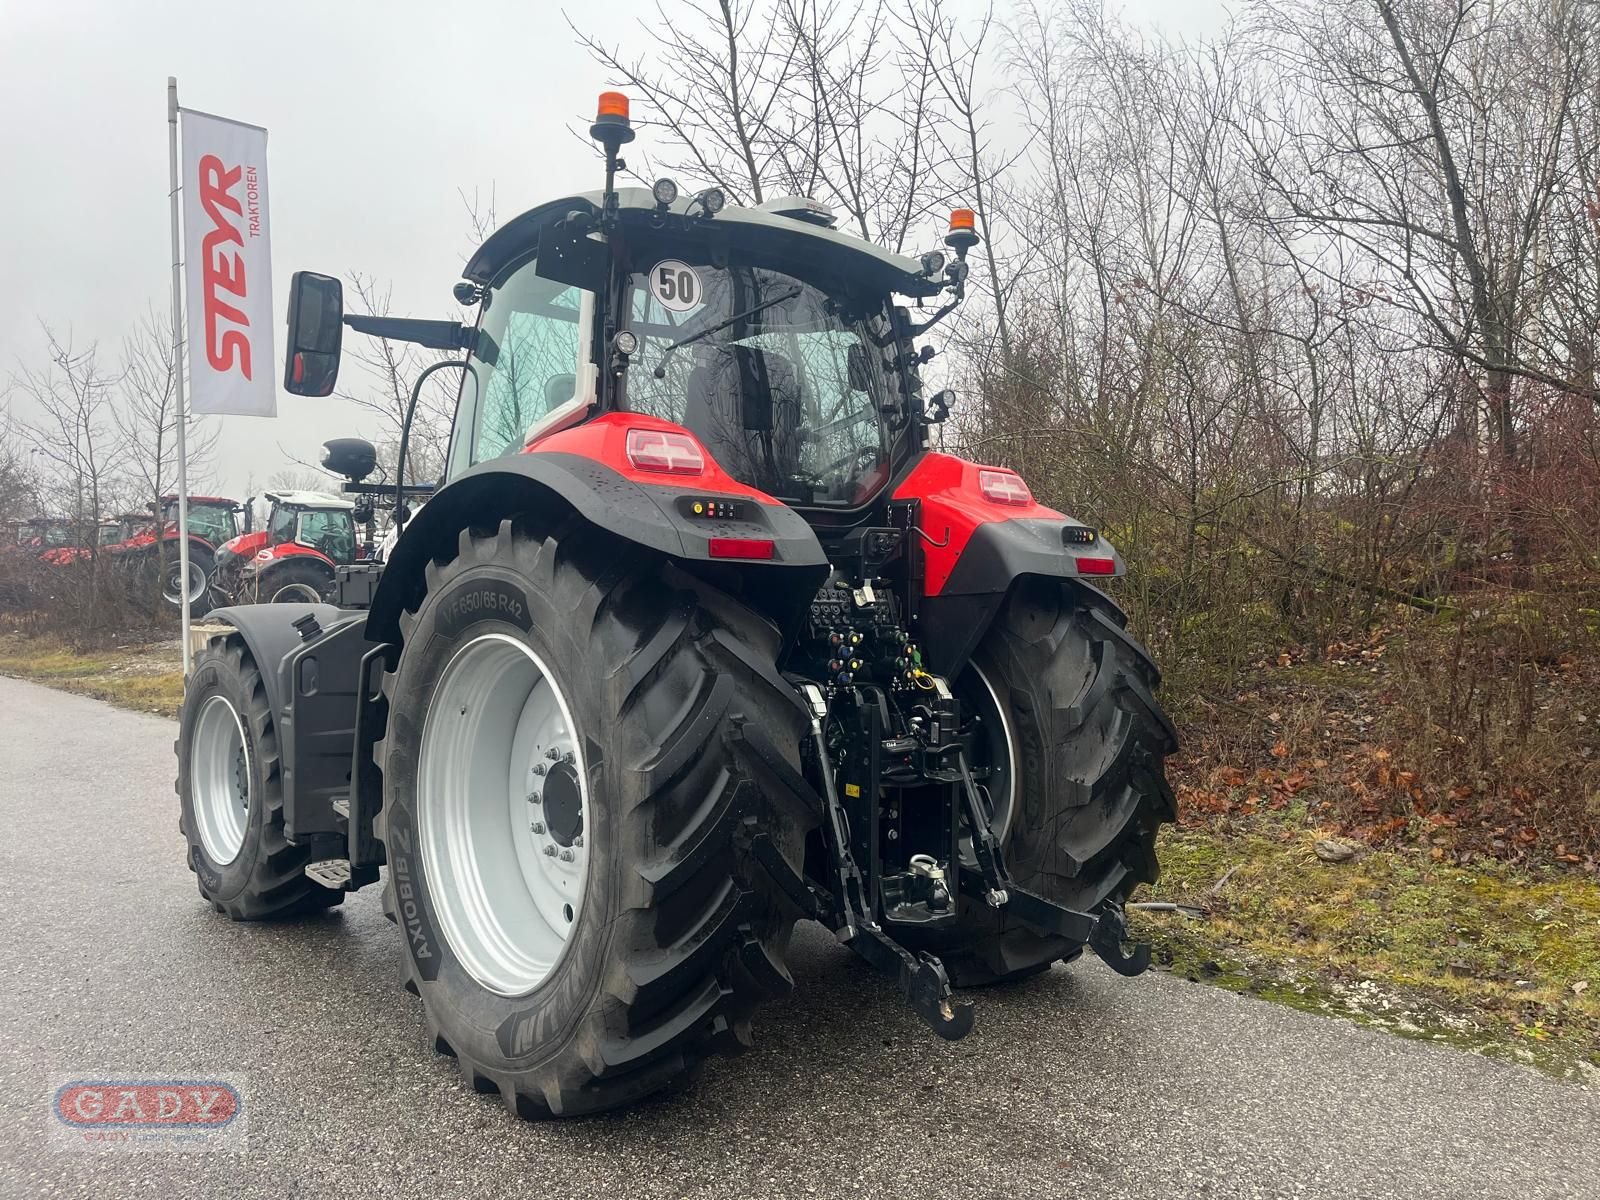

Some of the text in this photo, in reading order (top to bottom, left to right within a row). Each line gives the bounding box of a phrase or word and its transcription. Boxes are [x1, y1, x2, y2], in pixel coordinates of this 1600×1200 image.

[247, 166, 259, 238] TRAKTOREN
[198, 154, 252, 382] STEYR
[659, 267, 694, 304] 50
[396, 857, 433, 959] AXIOBIB
